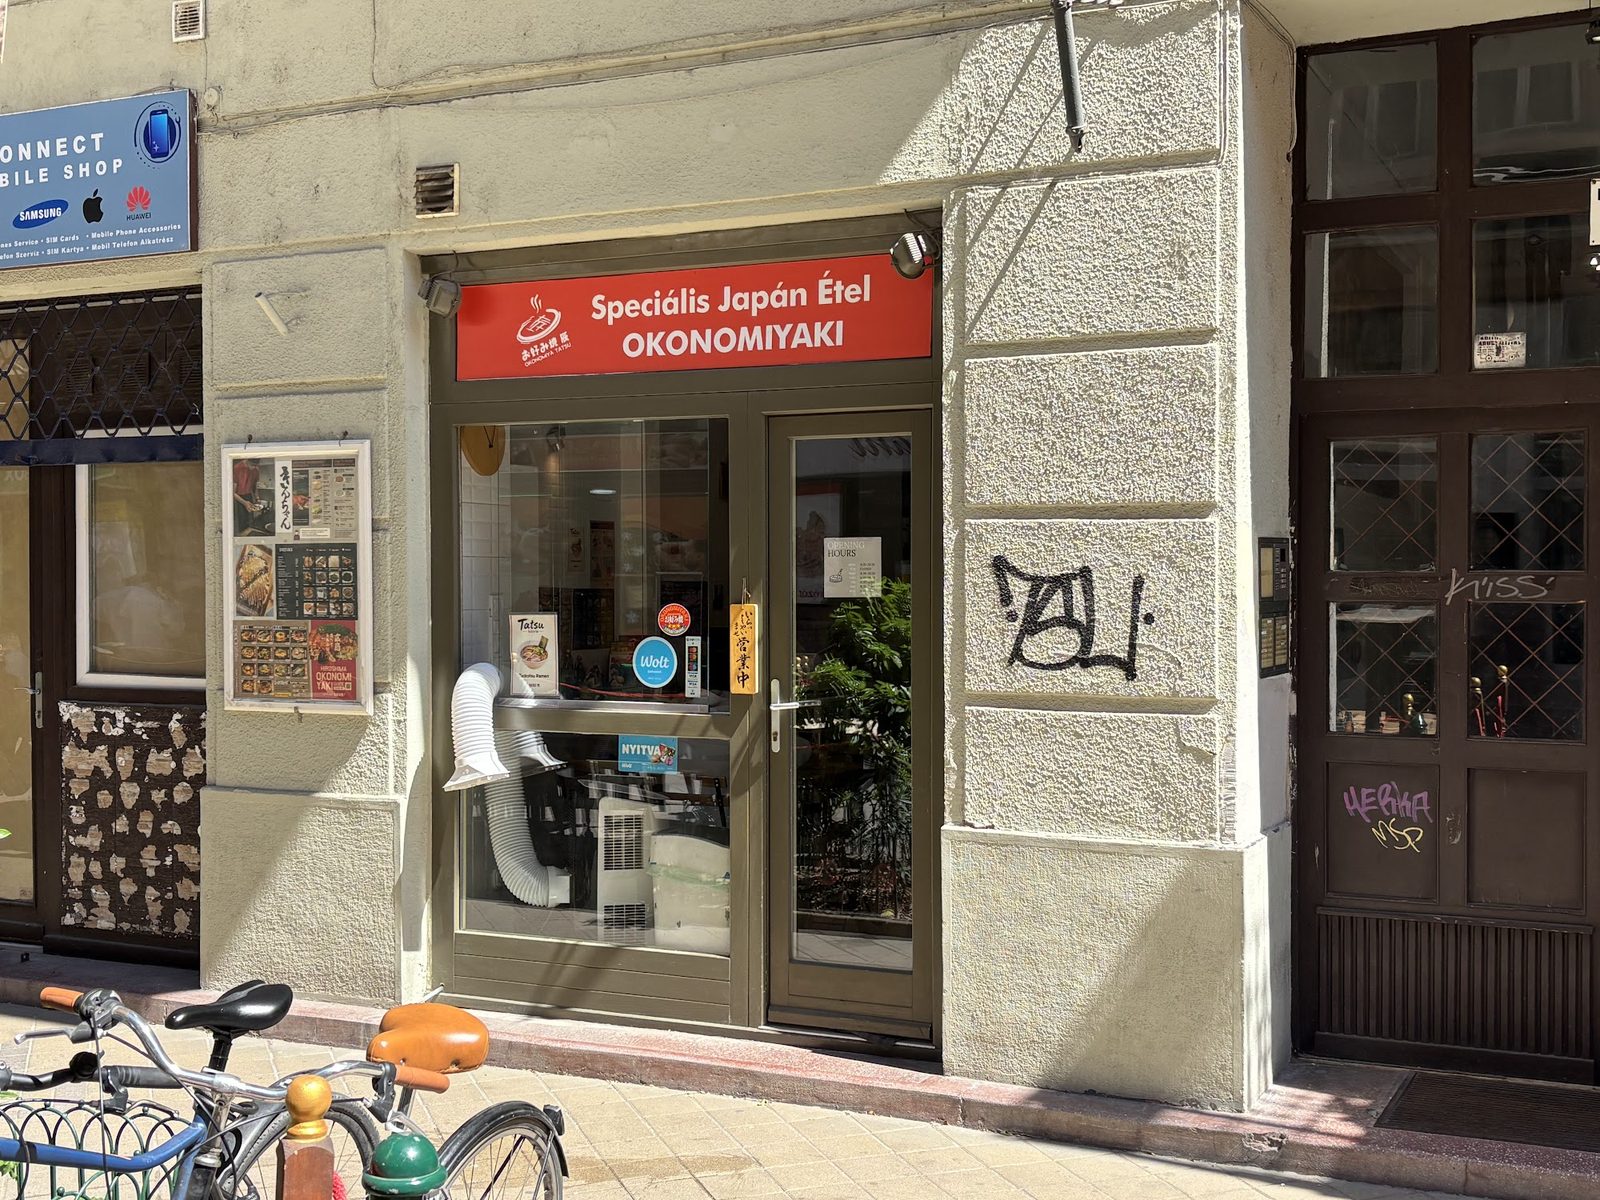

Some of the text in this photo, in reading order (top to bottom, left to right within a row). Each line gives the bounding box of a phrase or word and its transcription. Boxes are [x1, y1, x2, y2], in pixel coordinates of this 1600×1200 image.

[63, 158, 123, 180] SHOP
[20, 207, 62, 222] SAMSUNG
[126, 212, 152, 221] HUAWEI
[14, 240, 39, 248] Service
[60, 234, 80, 242] Cards
[91, 230, 114, 239] Mobile
[115, 228, 137, 236] Phone
[138, 223, 181, 234] Accessories
[15, 250, 40, 259] Szerviz
[91, 243, 111, 251] Mobil
[112, 240, 138, 248] Telefon
[140, 236, 174, 246] Alkatrész
[591, 271, 871, 326] Speciális Japán Étel
[622, 321, 844, 358] OKONOMIYAKI
[827, 541, 865, 549] OPENING
[827, 549, 857, 558] HOURS
[518, 619, 544, 631] Tatsu
[640, 655, 670, 669] Wolt
[736, 637, 750, 689] 営業中
[316, 672, 352, 681] OKONOMI
[317, 682, 333, 691] YAKI
[621, 743, 662, 756] NYITVA
